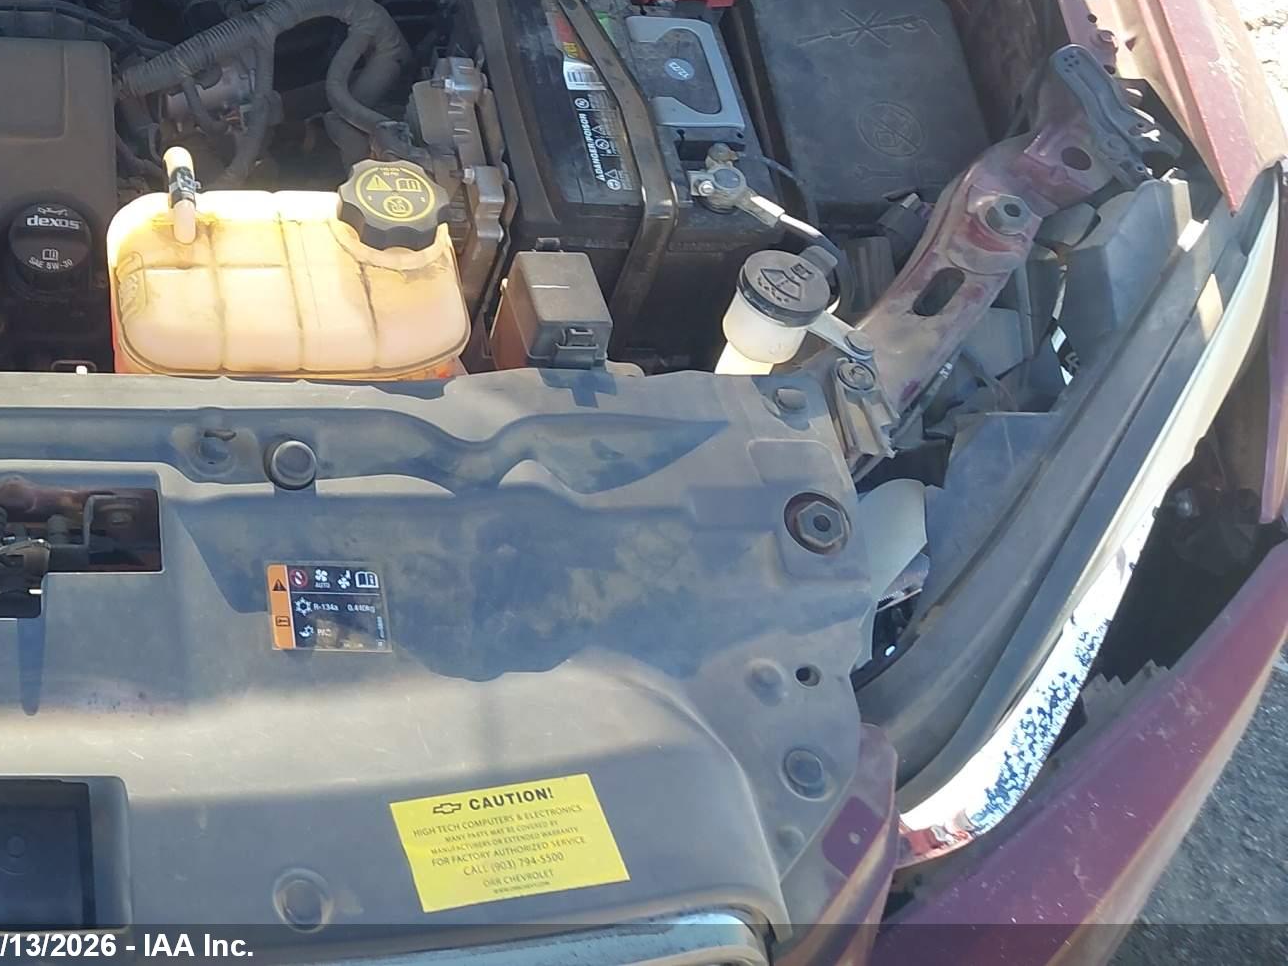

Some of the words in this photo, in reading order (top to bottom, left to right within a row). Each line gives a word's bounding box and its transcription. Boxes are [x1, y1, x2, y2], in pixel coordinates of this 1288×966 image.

[26, 215, 80, 230] dexos
[313, 603, 339, 612] R-134a
[469, 787, 555, 810] CAUTION!
[413, 826, 437, 838] HIGH
[437, 822, 461, 834] TECH
[462, 816, 515, 831] COMPUTERS
[524, 804, 583, 820] ELECTRONICS
[432, 856, 450, 866] FOR
[451, 850, 490, 864] FACTORY
[493, 842, 549, 857] AUTHORIZED
[550, 835, 586, 848] SERVICE
[463, 864, 489, 876] CALL
[503, 868, 554, 884] CHEVROLET
